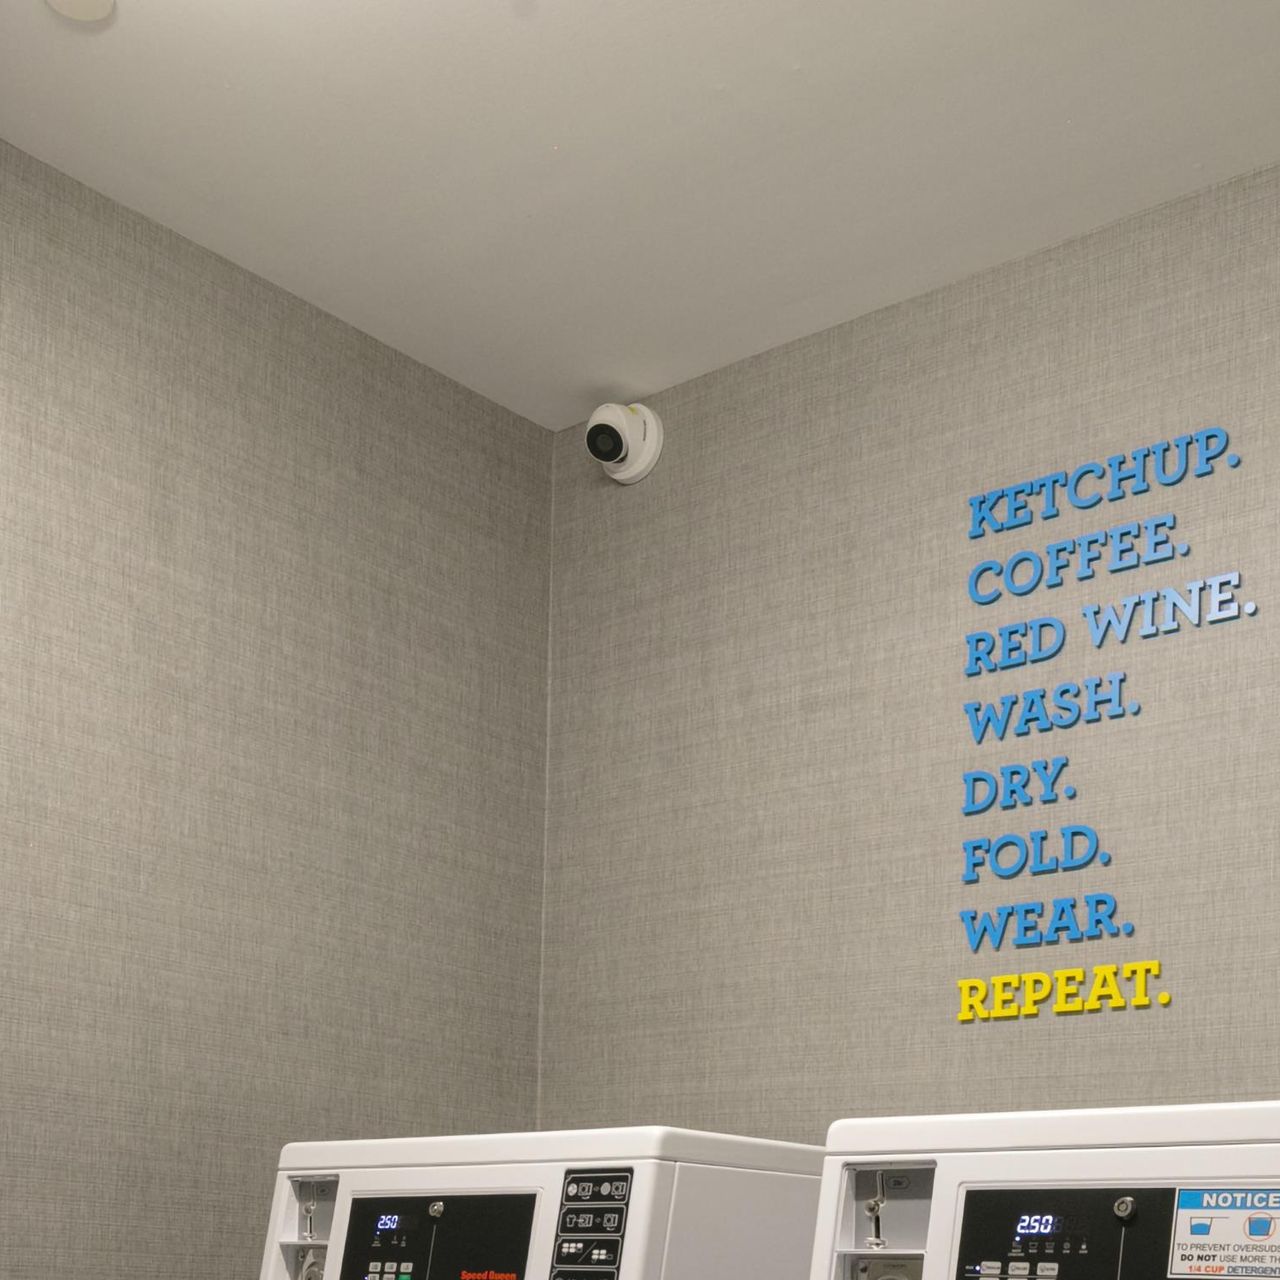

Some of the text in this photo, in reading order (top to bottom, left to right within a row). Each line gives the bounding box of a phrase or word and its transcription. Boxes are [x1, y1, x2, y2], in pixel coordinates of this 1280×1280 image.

[968, 427, 1240, 538] KETCHUP.
[968, 514, 1189, 604] COFFEE.
[964, 571, 1257, 676] RED WINE.
[964, 672, 1140, 744] WASH.
[962, 757, 1075, 815] DRY.
[962, 825, 1110, 883] FOLD.
[960, 893, 1134, 952] WEAR.
[957, 960, 1171, 1022] REPEAT.
[1016, 1215, 1053, 1233] 2.50
[1202, 1193, 1280, 1207] NOTICE
[489, 1271, 517, 1280] Queen
[1177, 1242, 1188, 1251] TO
[1190, 1243, 1231, 1252] PREVENT
[1181, 1254, 1195, 1262] DO
[1197, 1254, 1217, 1262] NOT
[1219, 1255, 1237, 1263] USE
[1240, 1255, 1266, 1263] MORE
[1188, 1265, 1202, 1273] 1/4
